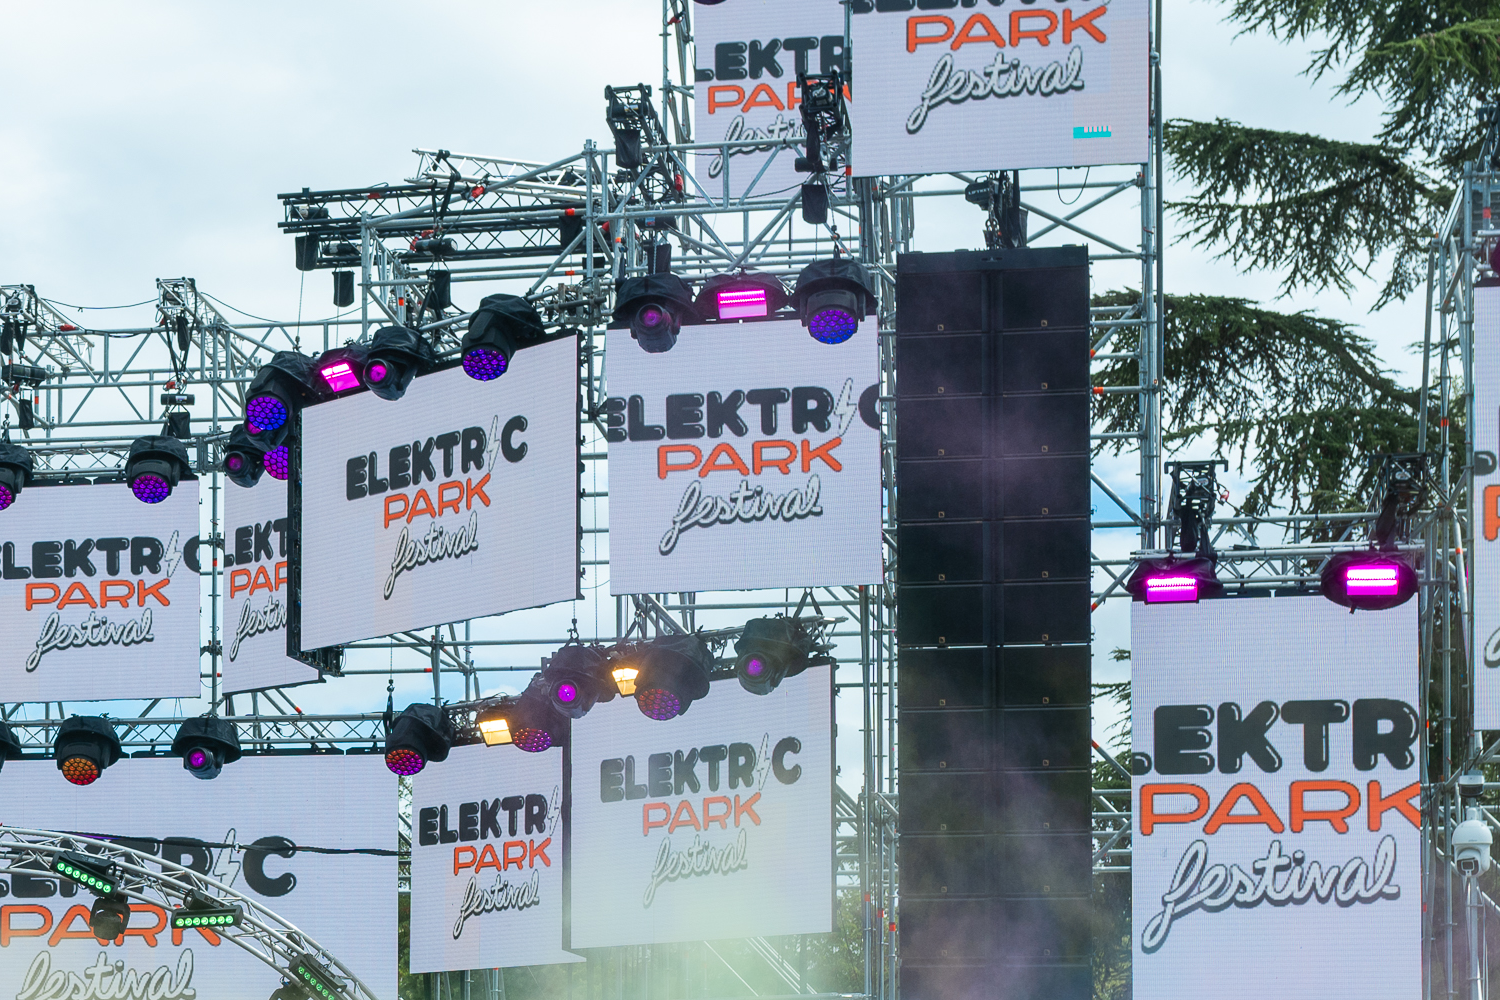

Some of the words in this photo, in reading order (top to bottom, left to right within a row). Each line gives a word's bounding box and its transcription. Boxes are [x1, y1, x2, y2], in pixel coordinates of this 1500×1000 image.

[906, 5, 1107, 53] PARK
[905, 46, 1084, 135] festival
[657, 436, 843, 480] PARK
[383, 472, 491, 529] PARK
[658, 473, 824, 557] festival
[383, 510, 479, 600] festival
[25, 578, 170, 611] PARK
[25, 607, 155, 673] festival
[642, 791, 762, 836] PARK
[1139, 779, 1420, 836] PARK
[453, 836, 552, 875] PARK
[642, 828, 748, 909] festival
[452, 868, 540, 940] festival
[1141, 834, 1400, 955] festival
